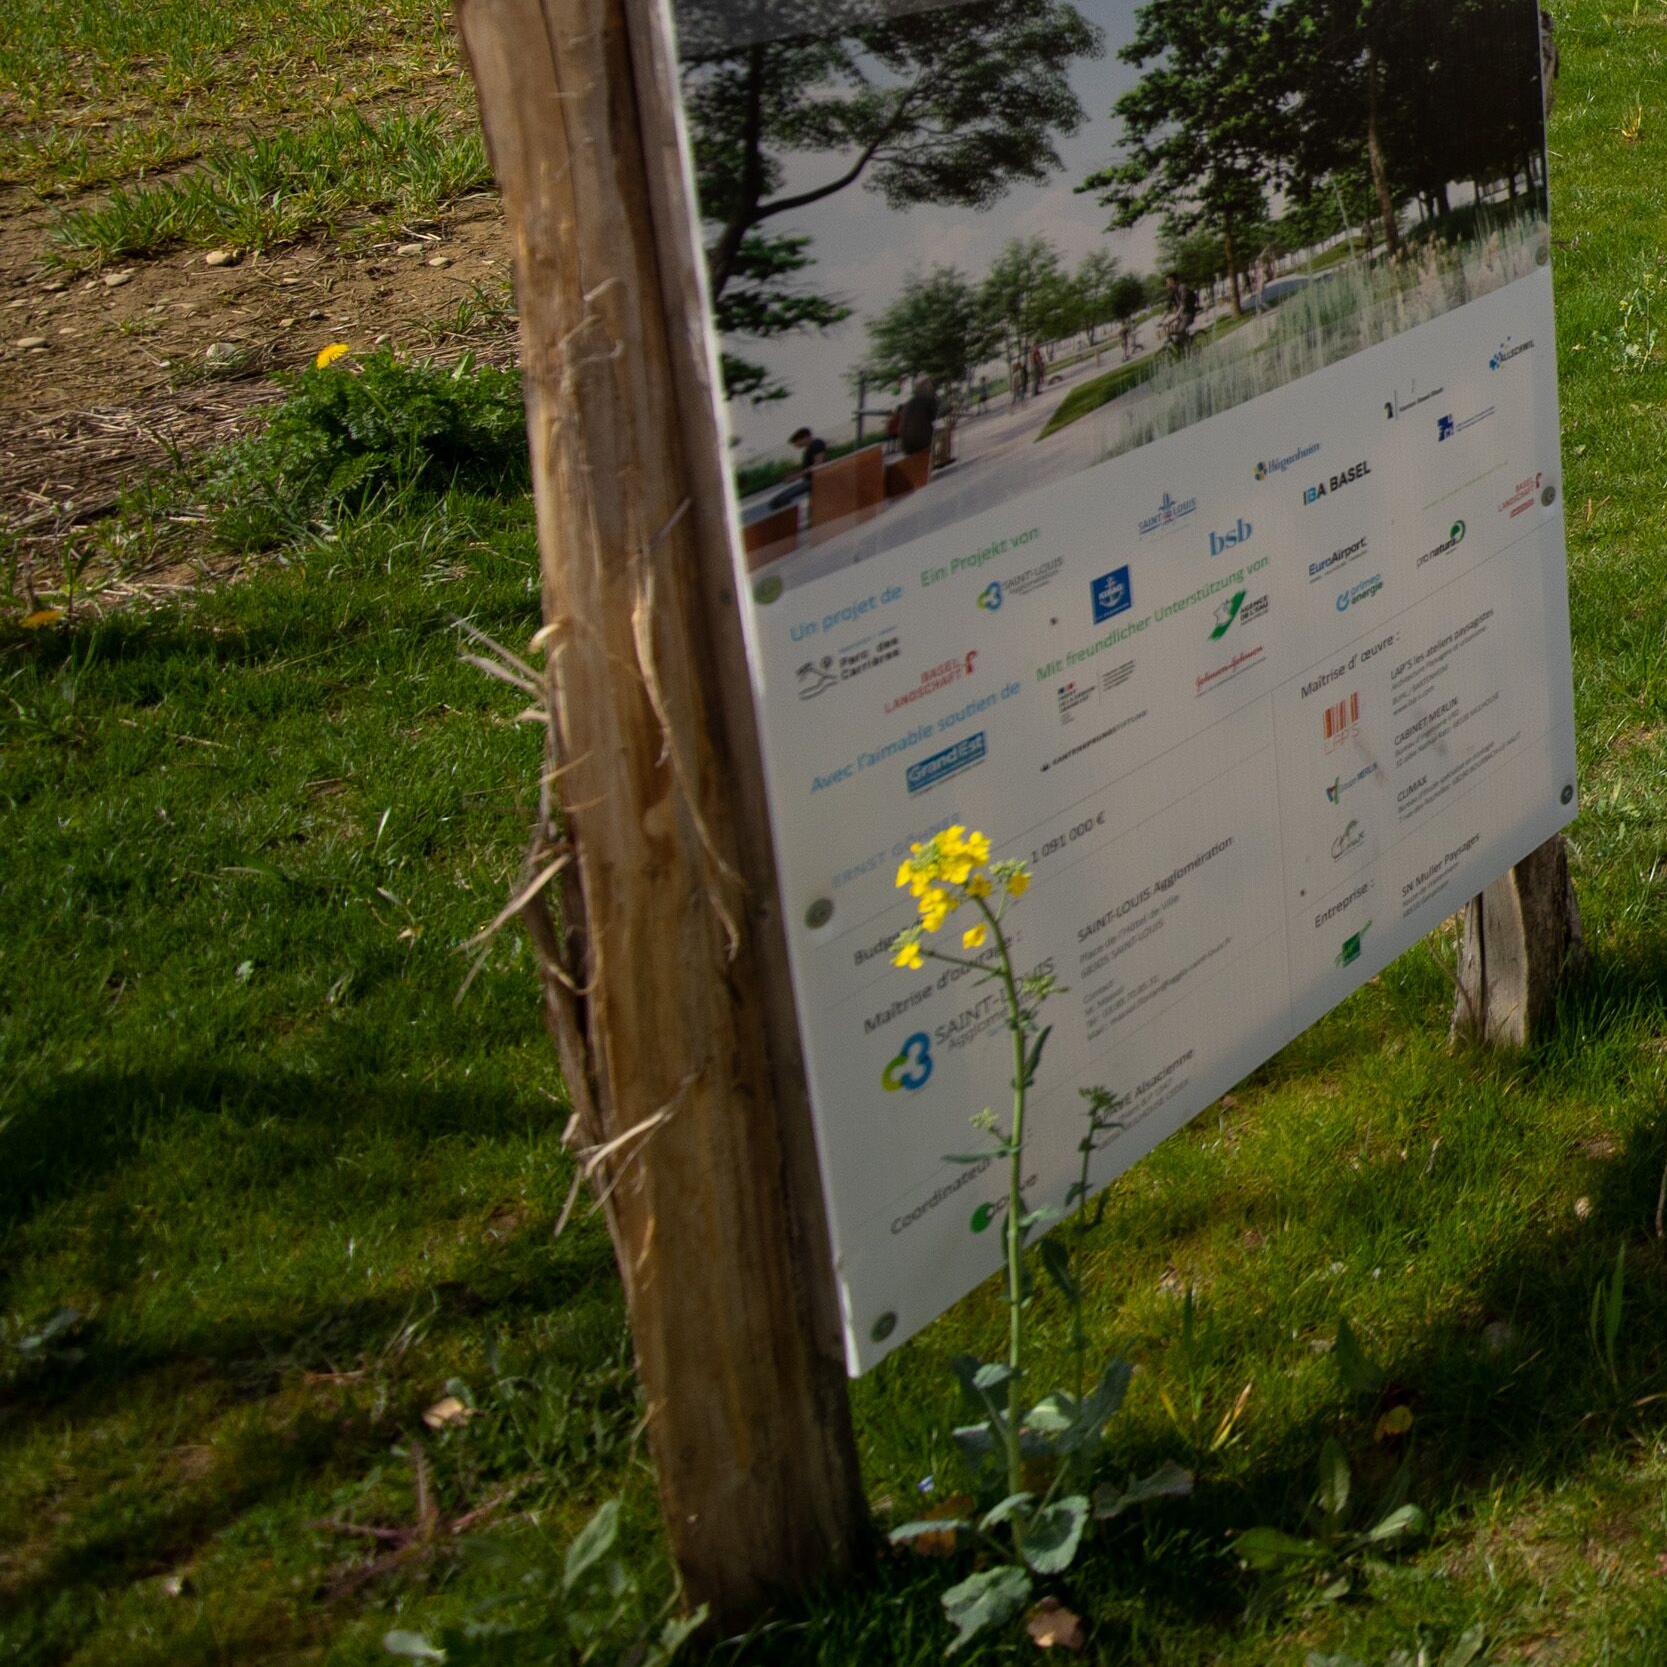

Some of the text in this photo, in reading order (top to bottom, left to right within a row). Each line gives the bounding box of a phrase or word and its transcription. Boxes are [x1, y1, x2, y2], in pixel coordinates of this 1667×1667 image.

[1302, 459, 1371, 506] IBA BASEL
[1138, 496, 1196, 531] SAINT LOUIS
[1208, 513, 1252, 557] bsb
[919, 524, 1040, 588] Ein Projekt von
[1308, 535, 1366, 575] EuroAirport
[789, 622, 817, 644] Un
[822, 592, 876, 633] projet
[880, 585, 903, 605] de
[1035, 656, 1062, 684] Mit
[1065, 615, 1150, 669] freundlicher
[1154, 568, 1243, 623] Unterstützung
[1246, 555, 1268, 575] von
[1413, 652, 1424, 665] les
[1425, 635, 1452, 657] ateliers
[1300, 664, 1345, 698] Maîtrise
[809, 763, 852, 796] Avec
[937, 693, 996, 733] soutien
[1000, 680, 1021, 700] de
[1394, 716, 1427, 747] CABINET
[1428, 695, 1457, 723] MERLIN
[1396, 773, 1427, 803] CLIMAX
[1076, 835, 1232, 945] SAINT-LOUIS Agglomération
[1401, 879, 1413, 898] SN
[1415, 860, 1442, 888] Muller
[1443, 832, 1479, 865] Paysages
[1314, 882, 1368, 927] Entreprise
[863, 982, 932, 1036] Maîtrise
[1134, 1048, 1194, 1100] Alsacienne
[889, 1151, 990, 1238] Coordinateu
